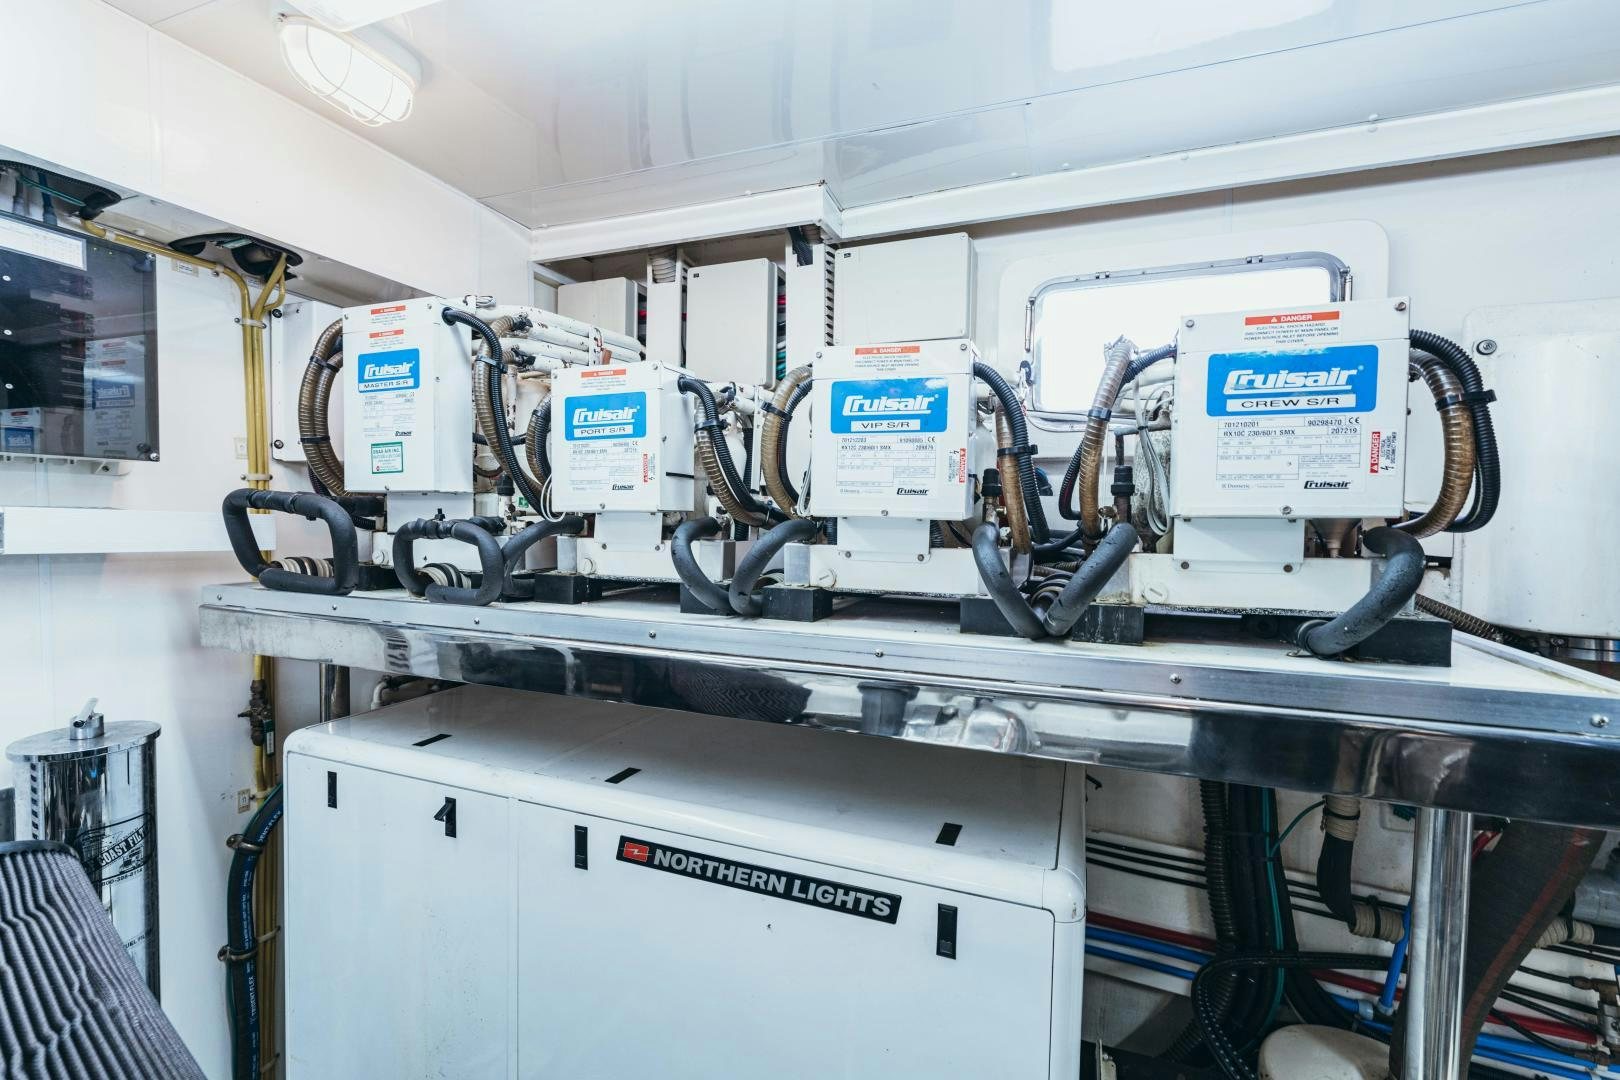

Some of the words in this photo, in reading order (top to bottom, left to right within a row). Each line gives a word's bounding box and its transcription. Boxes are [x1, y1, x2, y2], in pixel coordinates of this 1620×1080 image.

[1280, 314, 1312, 322] DANGER
[364, 362, 413, 379] Cruisair
[1224, 367, 1357, 395] Cruisair
[842, 394, 934, 416] Cruisair
[1241, 400, 1299, 409] CREW
[1307, 397, 1340, 406] S/R
[573, 407, 638, 425] Cruisair
[1371, 433, 1380, 464] DANGER
[1304, 480, 1351, 489] Cruisair
[100, 842, 127, 866] COAST
[653, 848, 787, 894] NORTHERN
[791, 879, 891, 917] LIGHTS
